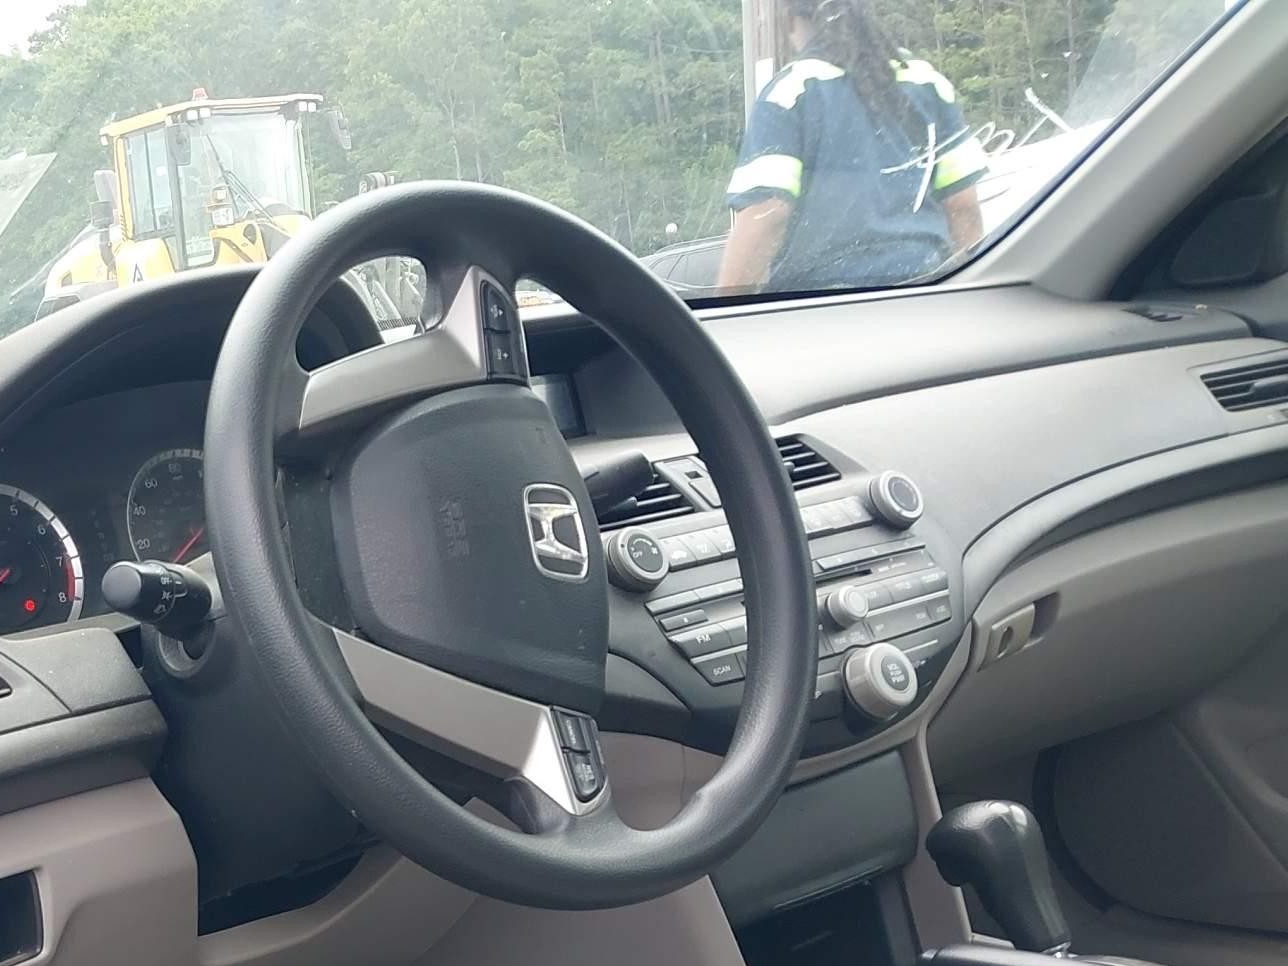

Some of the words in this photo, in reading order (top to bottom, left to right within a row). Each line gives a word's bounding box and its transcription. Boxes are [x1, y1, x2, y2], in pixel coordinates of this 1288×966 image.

[145, 478, 158, 489] 60
[10, 504, 18, 516] 5
[133, 503, 146, 516] 40
[37, 524, 46, 535] 6
[137, 538, 150, 550] 20
[56, 556, 63, 567] 7
[58, 592, 67, 603] 8
[696, 633, 711, 644] FM
[713, 665, 731, 676] SCAN
